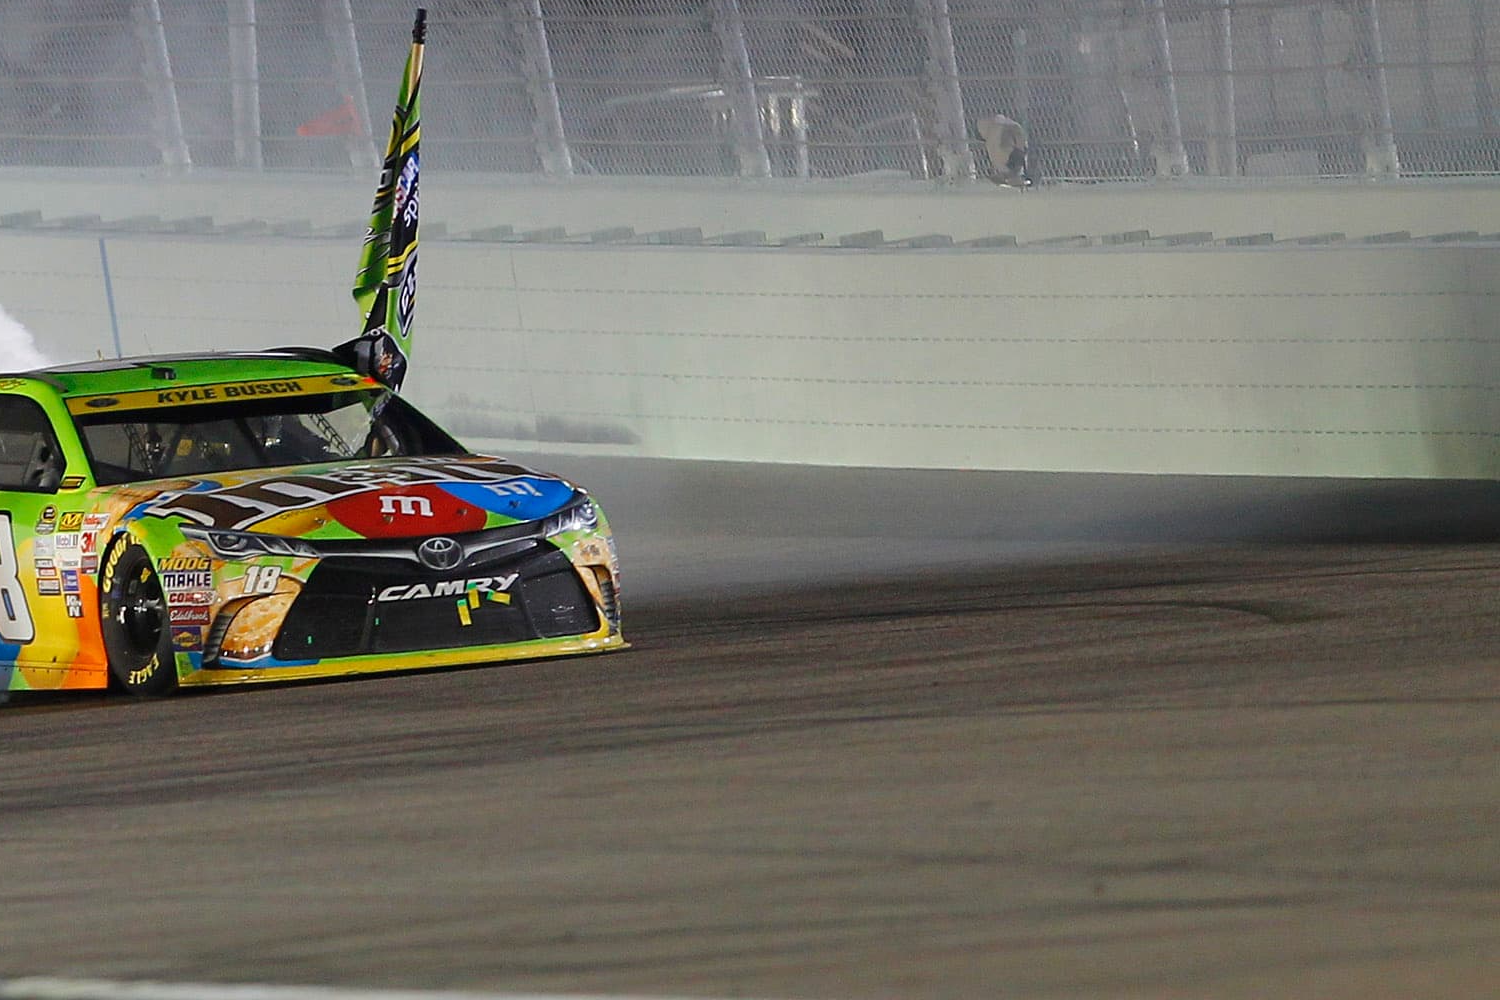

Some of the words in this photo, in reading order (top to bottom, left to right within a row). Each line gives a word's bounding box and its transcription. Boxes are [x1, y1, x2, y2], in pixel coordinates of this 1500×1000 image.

[157, 387, 217, 404] KYLE
[224, 382, 303, 398] BUSCH
[379, 495, 433, 517] m
[81, 532, 97, 553] 3M
[158, 558, 210, 571] MOOG
[164, 573, 211, 588] MAHLE
[243, 565, 282, 594] 18
[378, 573, 520, 602] CAMRY
[128, 653, 159, 684] EAGLE
